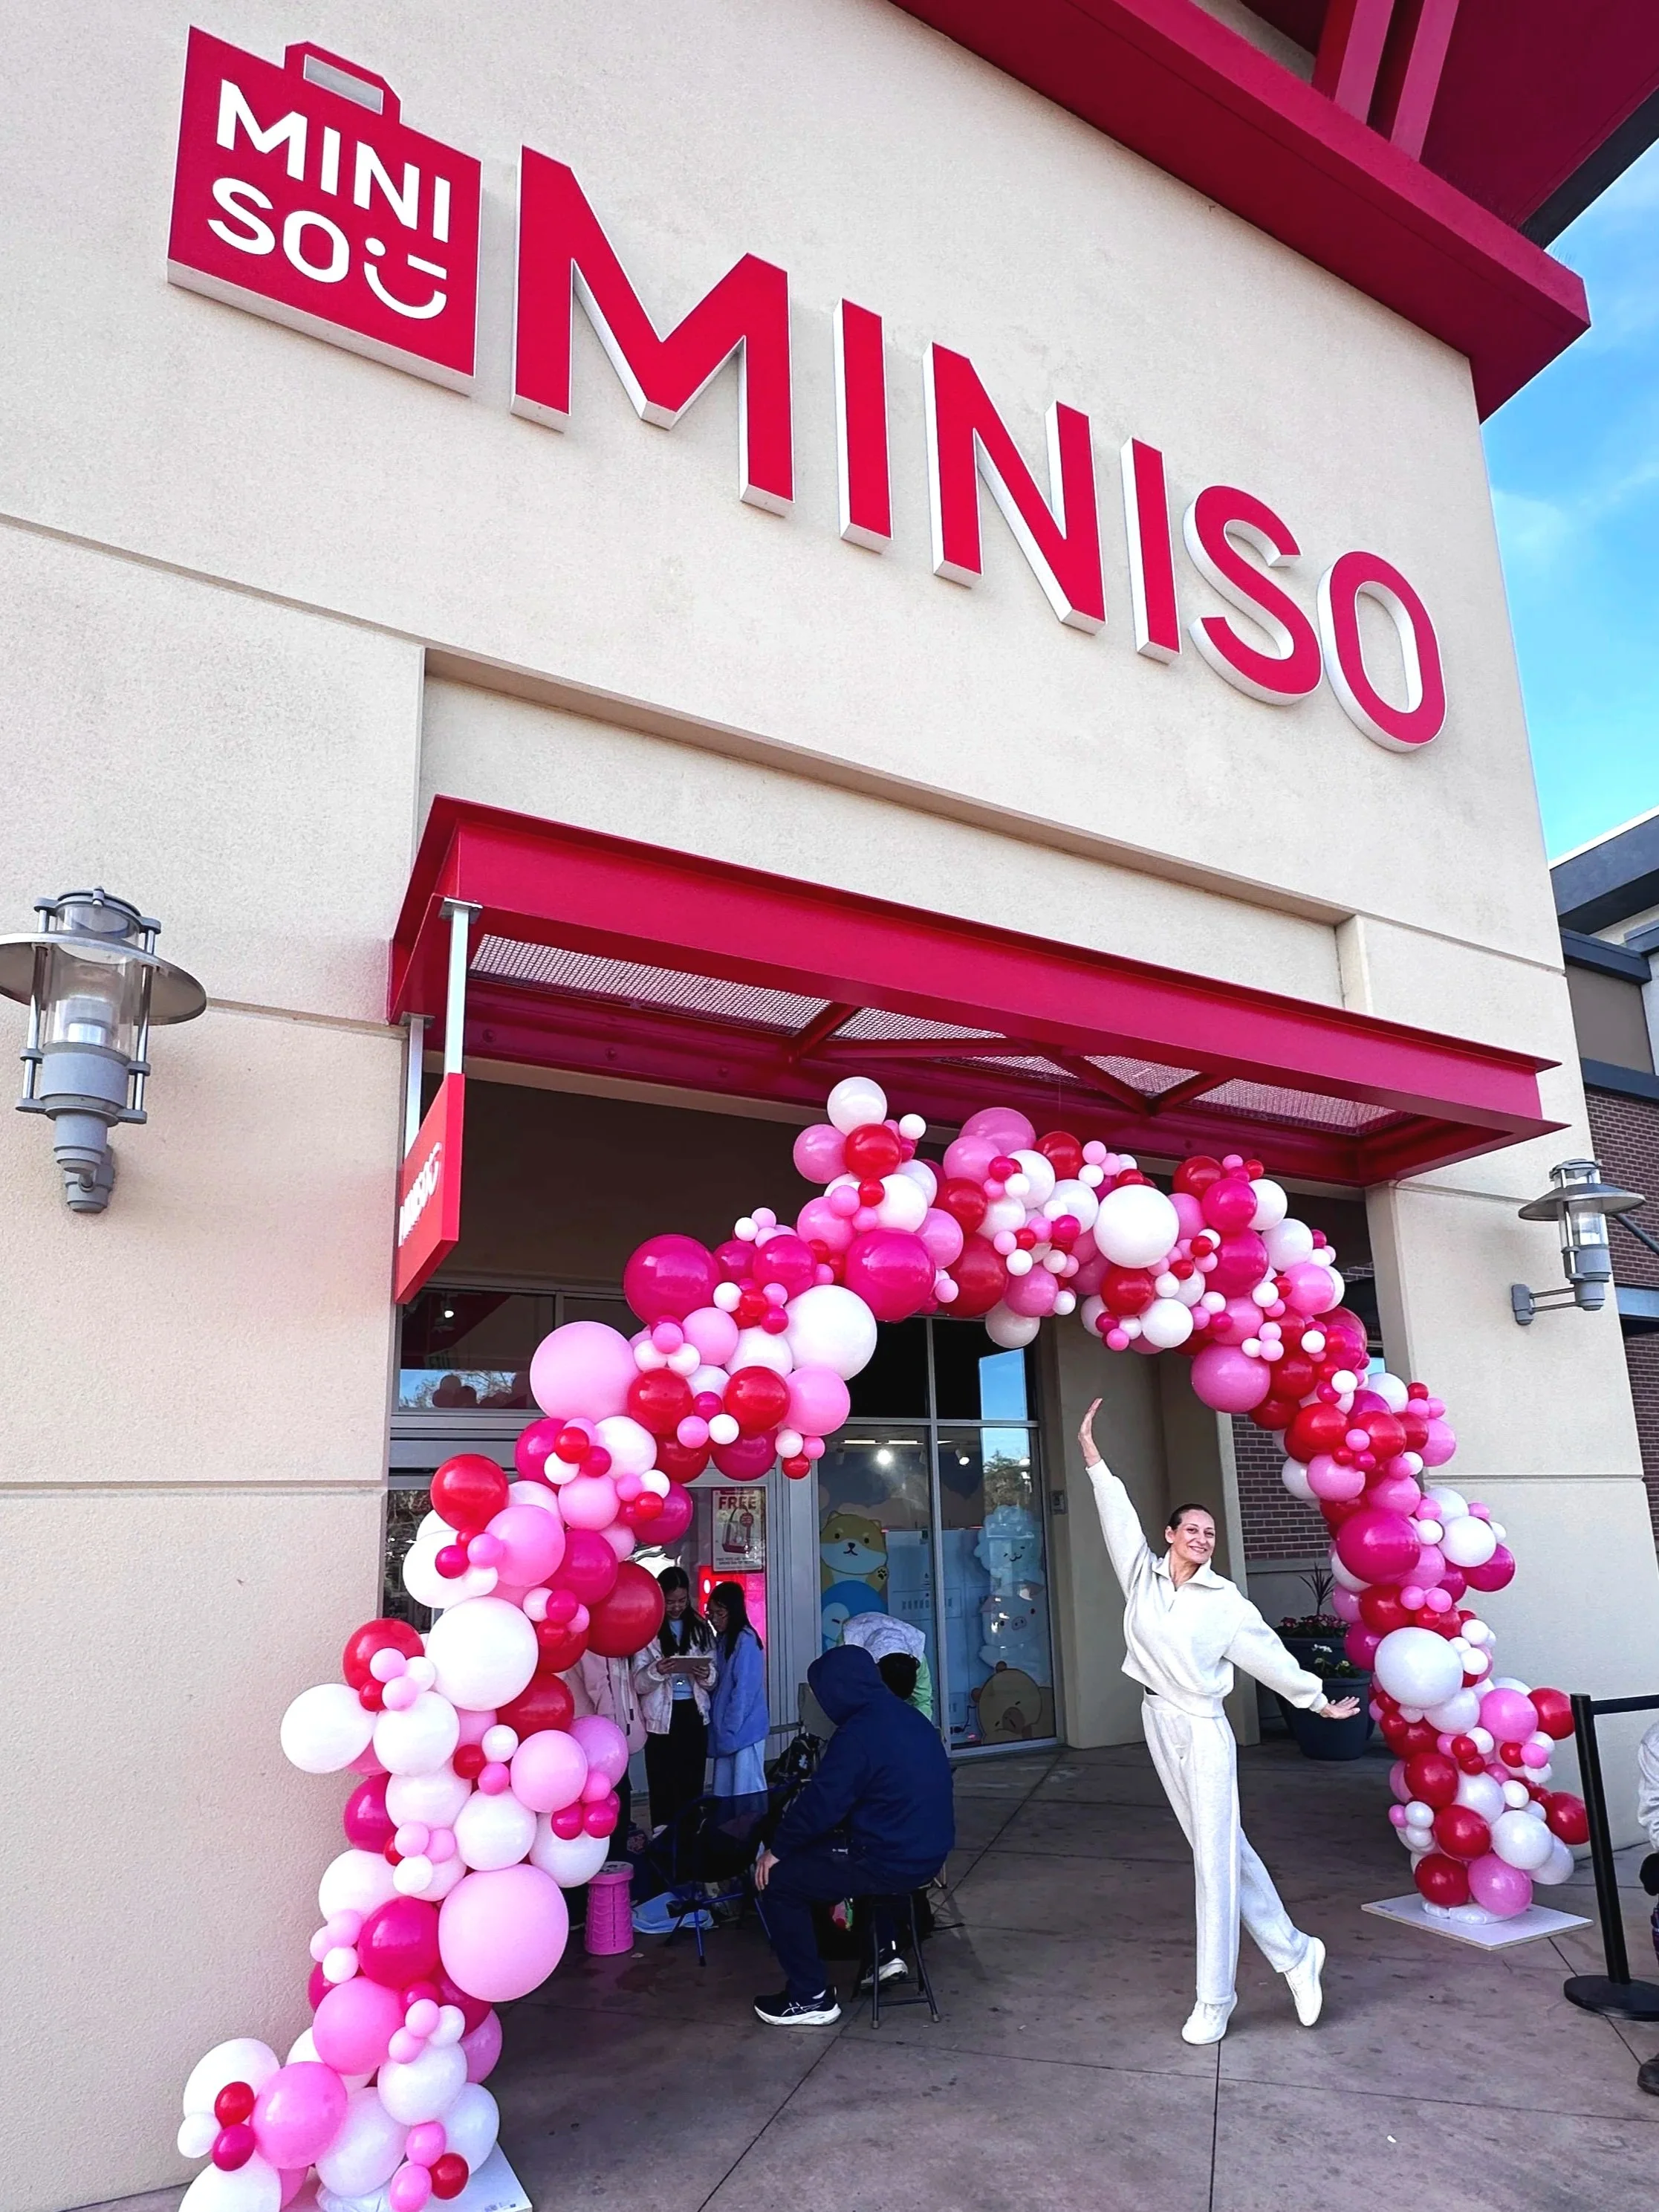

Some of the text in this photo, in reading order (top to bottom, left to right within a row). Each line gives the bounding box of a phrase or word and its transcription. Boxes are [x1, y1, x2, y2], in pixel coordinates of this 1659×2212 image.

[216, 78, 451, 244] MINI
[513, 144, 1448, 750] MINISO
[718, 1496, 756, 1510] FREE
